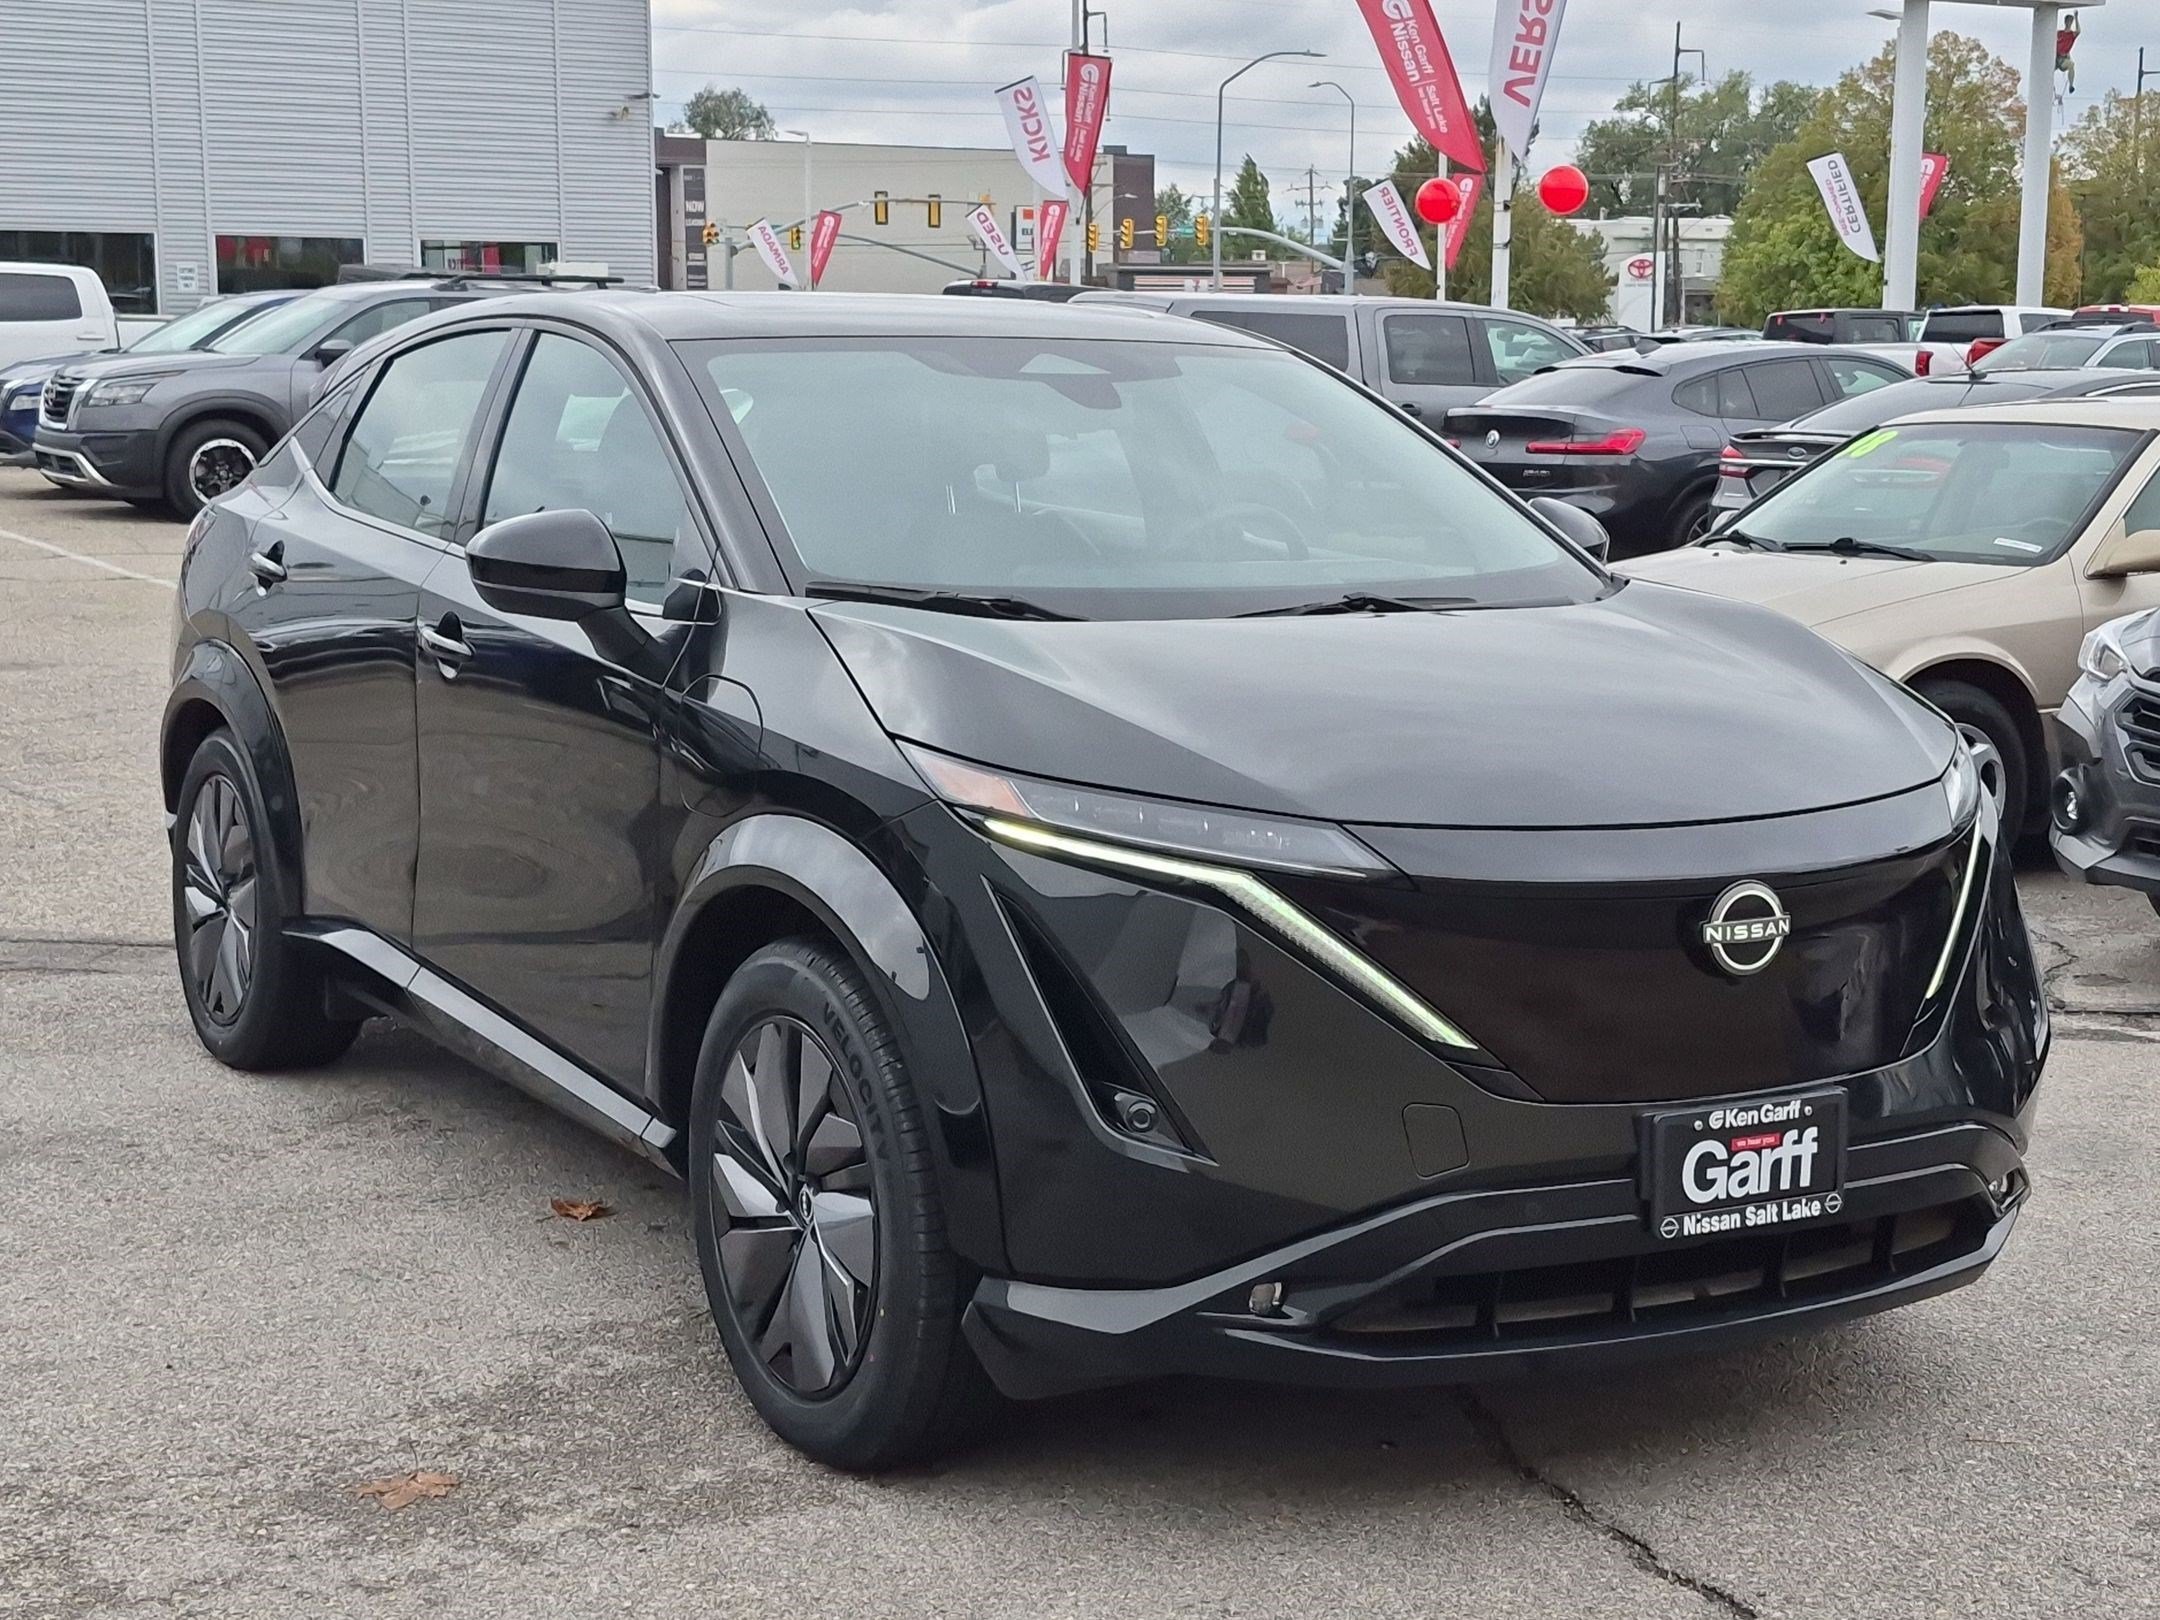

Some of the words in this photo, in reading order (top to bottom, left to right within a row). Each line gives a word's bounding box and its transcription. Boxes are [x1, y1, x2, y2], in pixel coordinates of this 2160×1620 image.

[1390, 22, 1421, 82] Nissan
[1405, 19, 1419, 44] Ken
[1415, 44, 1435, 74] Garff
[1073, 82, 1088, 123] Nissan
[1426, 84, 1440, 105] Salt
[1433, 107, 1448, 133] Lake
[685, 201, 705, 213] NOW
[1706, 919, 1789, 941] NISSAN
[824, 1002, 890, 1160] VELOCITY
[1725, 1107, 1759, 1128] Ken
[1760, 1100, 1801, 1124] Garff
[1682, 1126, 1819, 1204] Garff
[1683, 1211, 1741, 1236] Nissan
[1745, 1204, 1779, 1226] Salt
[1782, 1198, 1822, 1221] Lake
